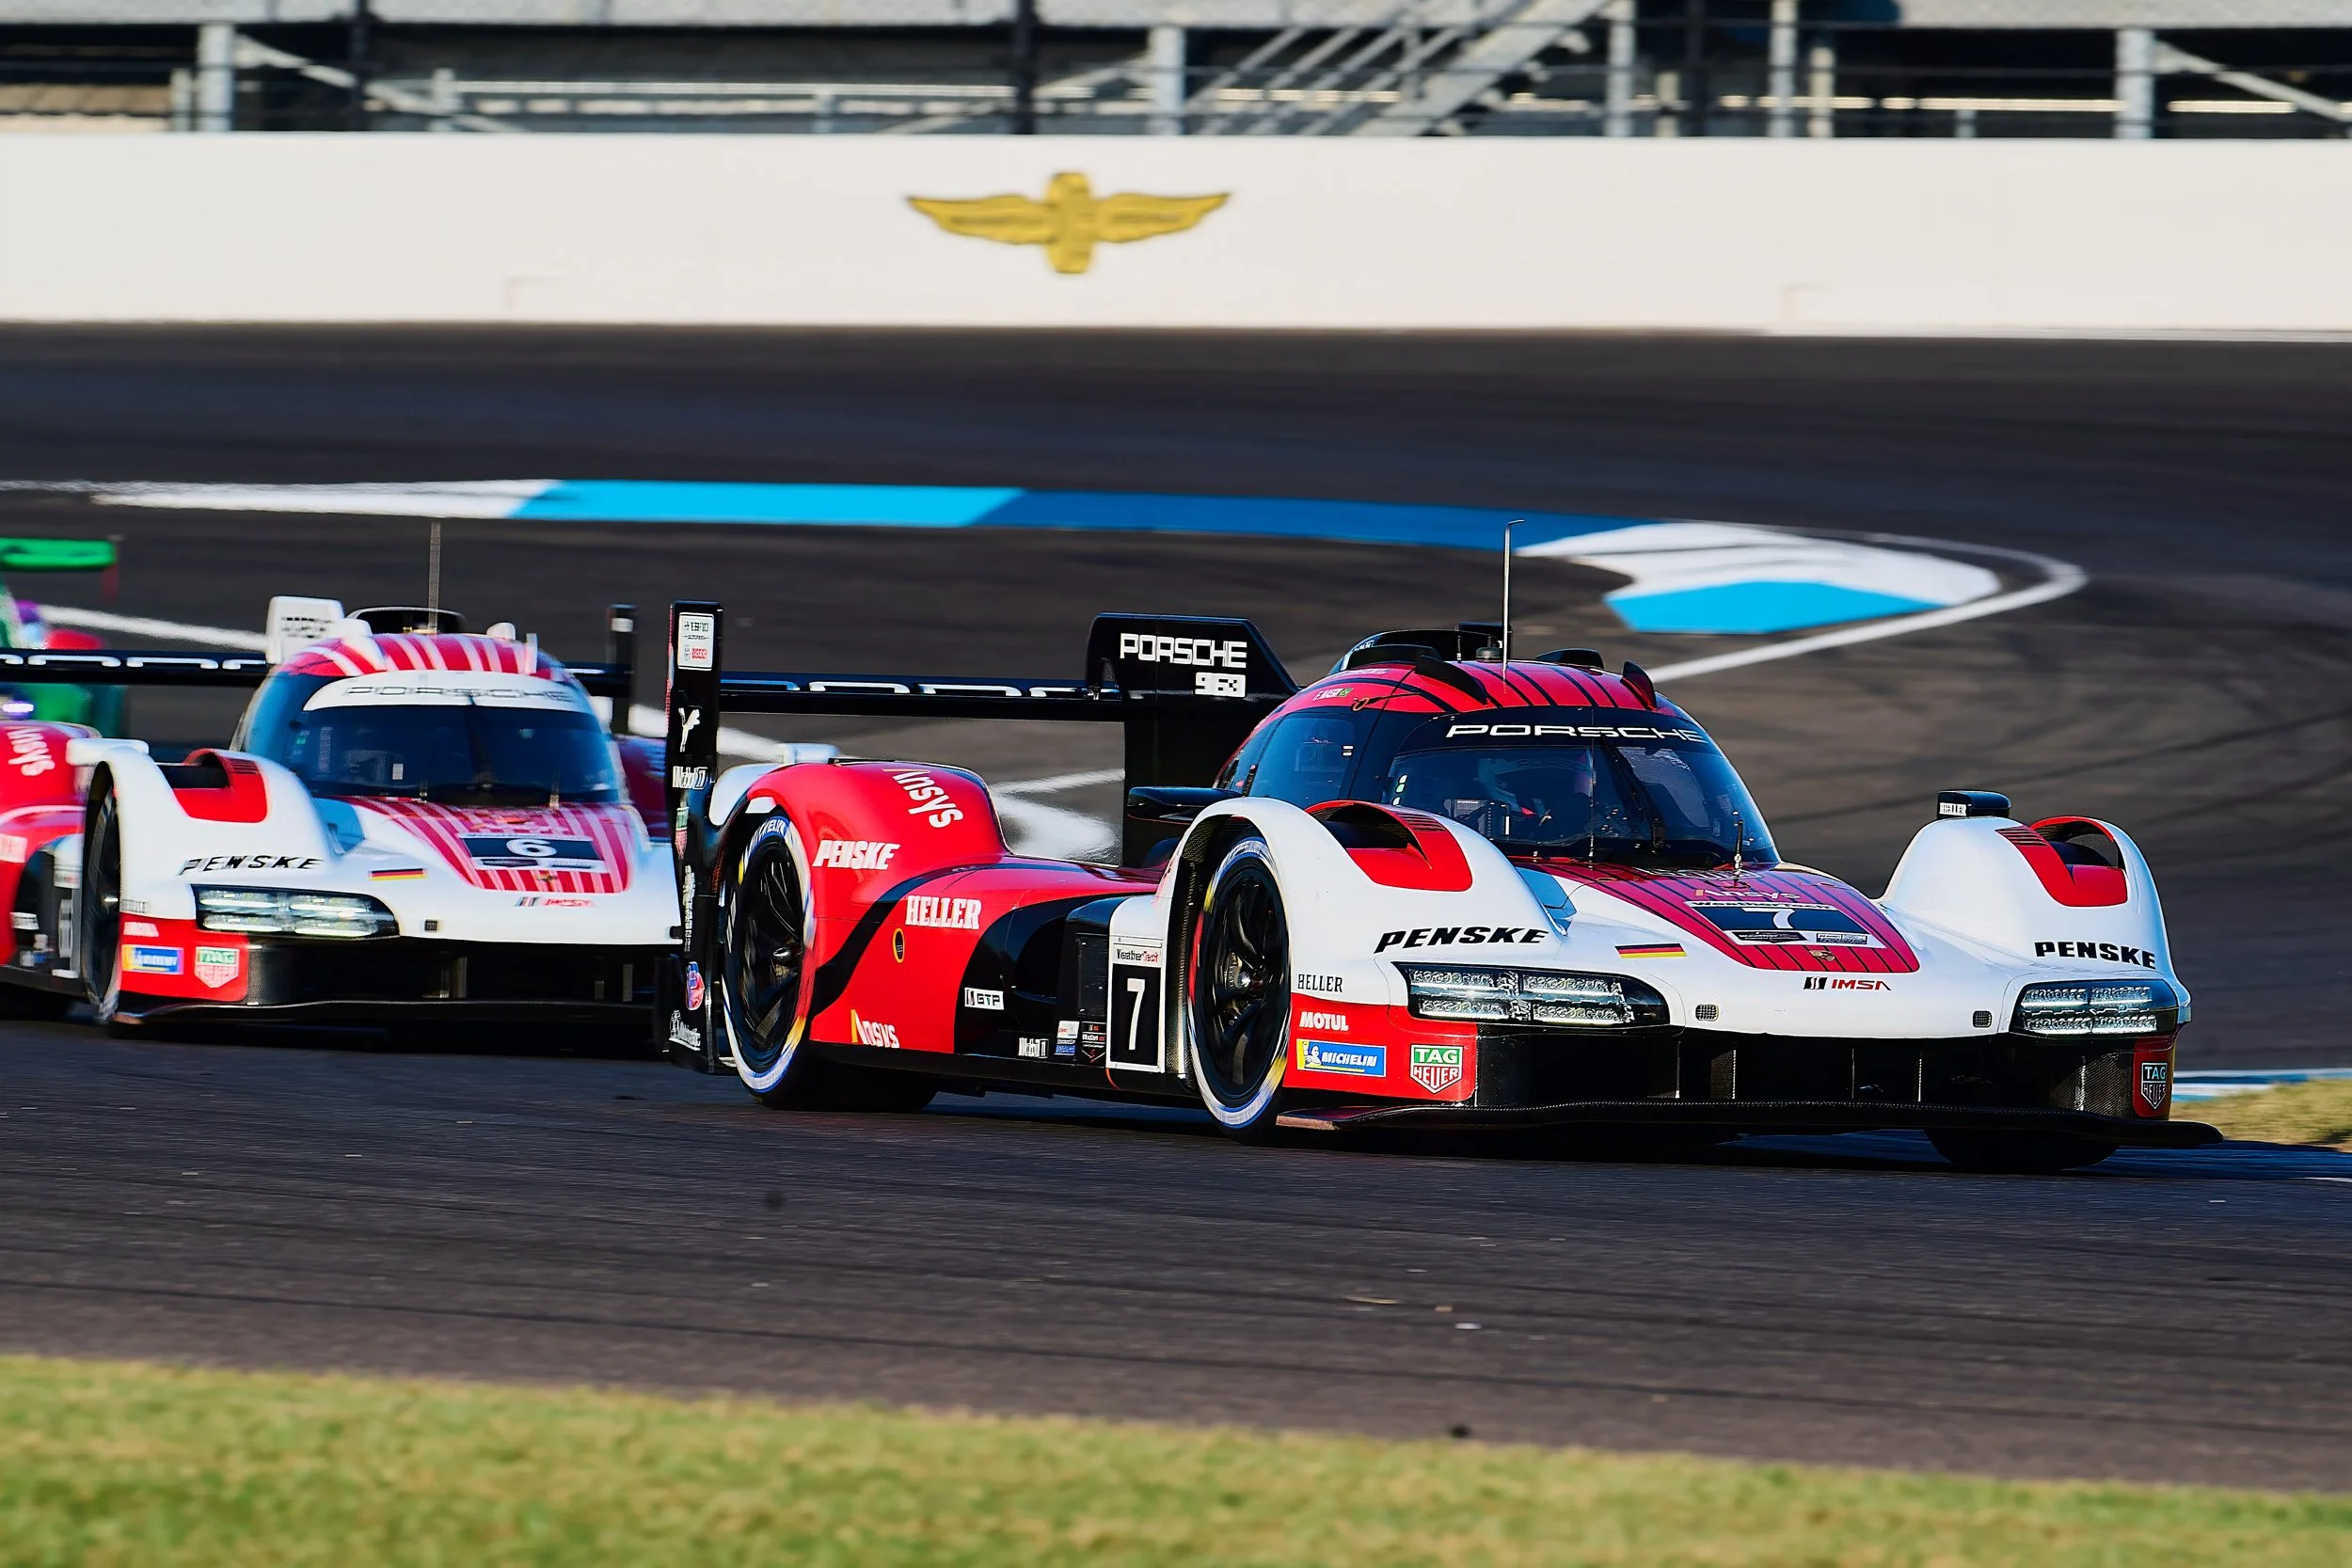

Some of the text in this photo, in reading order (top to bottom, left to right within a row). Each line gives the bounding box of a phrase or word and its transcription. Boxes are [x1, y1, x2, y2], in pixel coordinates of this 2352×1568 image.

[1120, 633, 1248, 669] PORSCHE
[1446, 724, 1708, 744] PORSCHE
[882, 768, 964, 829] Ansys
[506, 838, 557, 857] 6
[812, 839, 900, 870] PENSKE
[176, 855, 324, 876] PENSKE
[905, 895, 982, 930] HELLER
[1740, 907, 1796, 929] 7
[1374, 927, 1549, 954] PENSKE
[2034, 942, 2156, 970] PENSKE
[1297, 974, 1343, 993] HELLER
[1831, 978, 1892, 990] IMSA
[977, 992, 1001, 1006] GTP
[1126, 977, 1146, 1051] 7
[1299, 1011, 1349, 1032] MOTUL
[850, 1008, 900, 1049] Ansys
[1321, 1052, 1378, 1068] MICHELIN
[1415, 1049, 1457, 1064] TAG
[1413, 1066, 1459, 1088] HEUER
[2145, 1066, 2167, 1080] TAG
